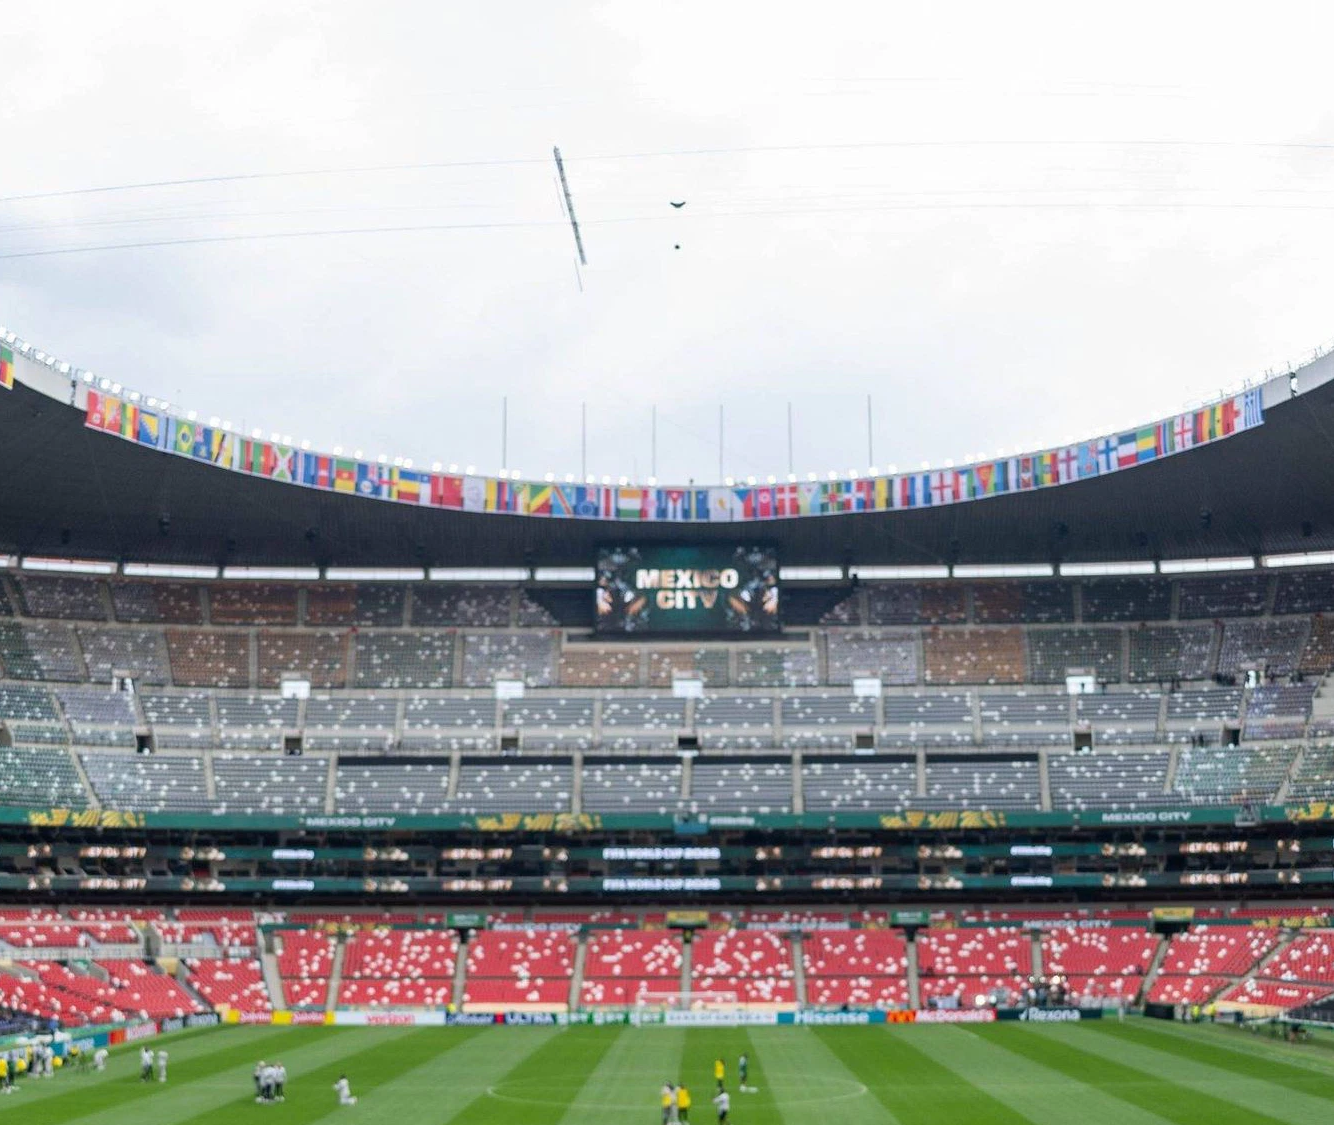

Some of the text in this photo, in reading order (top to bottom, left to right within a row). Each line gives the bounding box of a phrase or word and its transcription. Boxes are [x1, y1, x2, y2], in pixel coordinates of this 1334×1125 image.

[636, 568, 739, 589] MEXICO
[656, 590, 718, 609] CITY
[1101, 811, 1191, 822] MEXICO CITY
[1072, 919, 1111, 929] CITY
[505, 1013, 555, 1025] ULTRA
[795, 1010, 870, 1023] Hisense
[916, 1009, 995, 1021] McDonald's
[1028, 1009, 1080, 1021] Rexona
